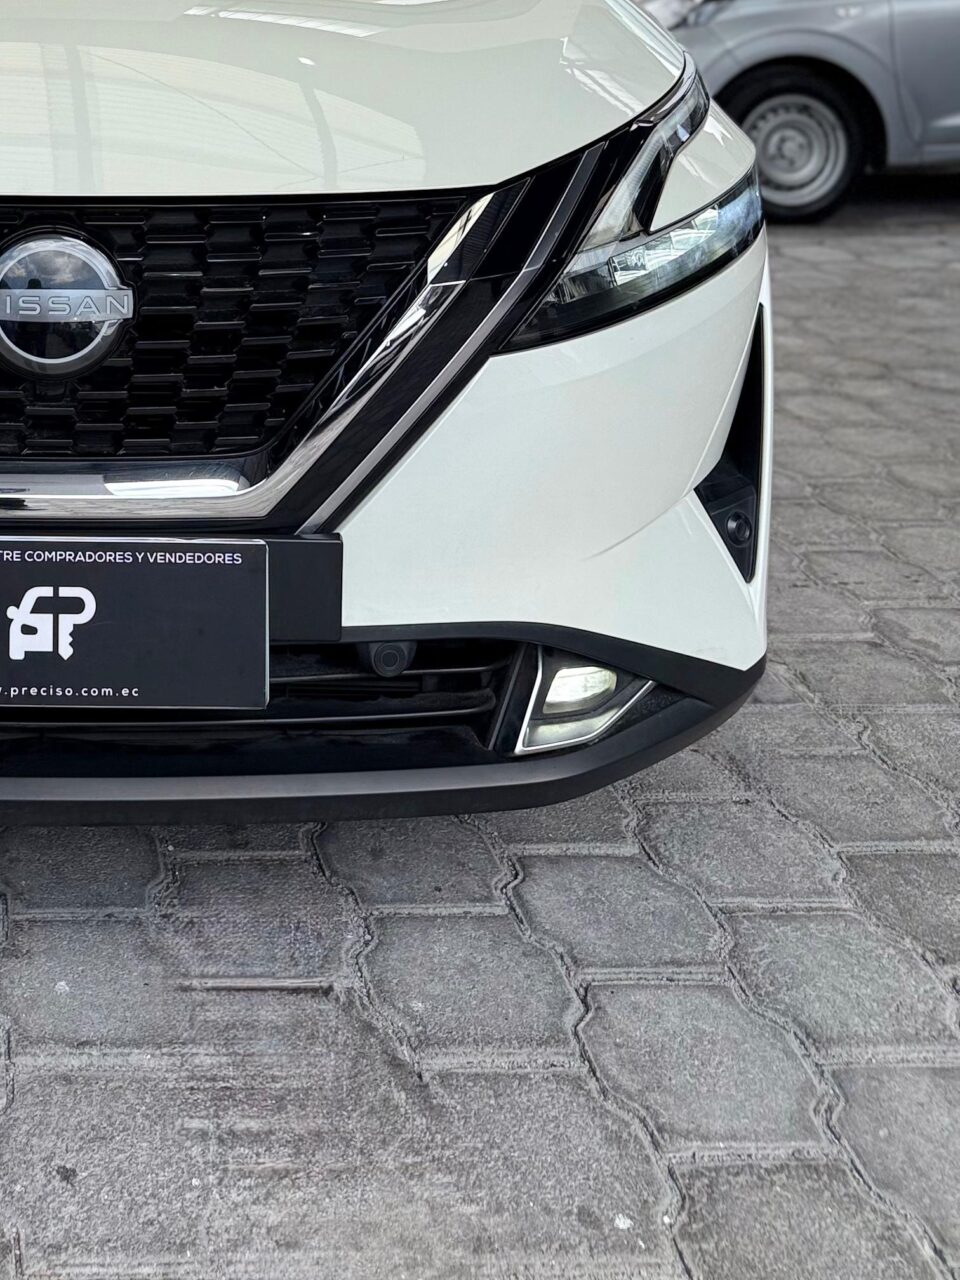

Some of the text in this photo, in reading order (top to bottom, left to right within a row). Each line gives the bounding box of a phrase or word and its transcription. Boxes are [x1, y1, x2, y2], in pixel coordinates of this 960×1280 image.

[24, 550, 133, 564] COMPRADORES
[136, 551, 146, 563] Y
[146, 552, 243, 565] VENDEDORES
